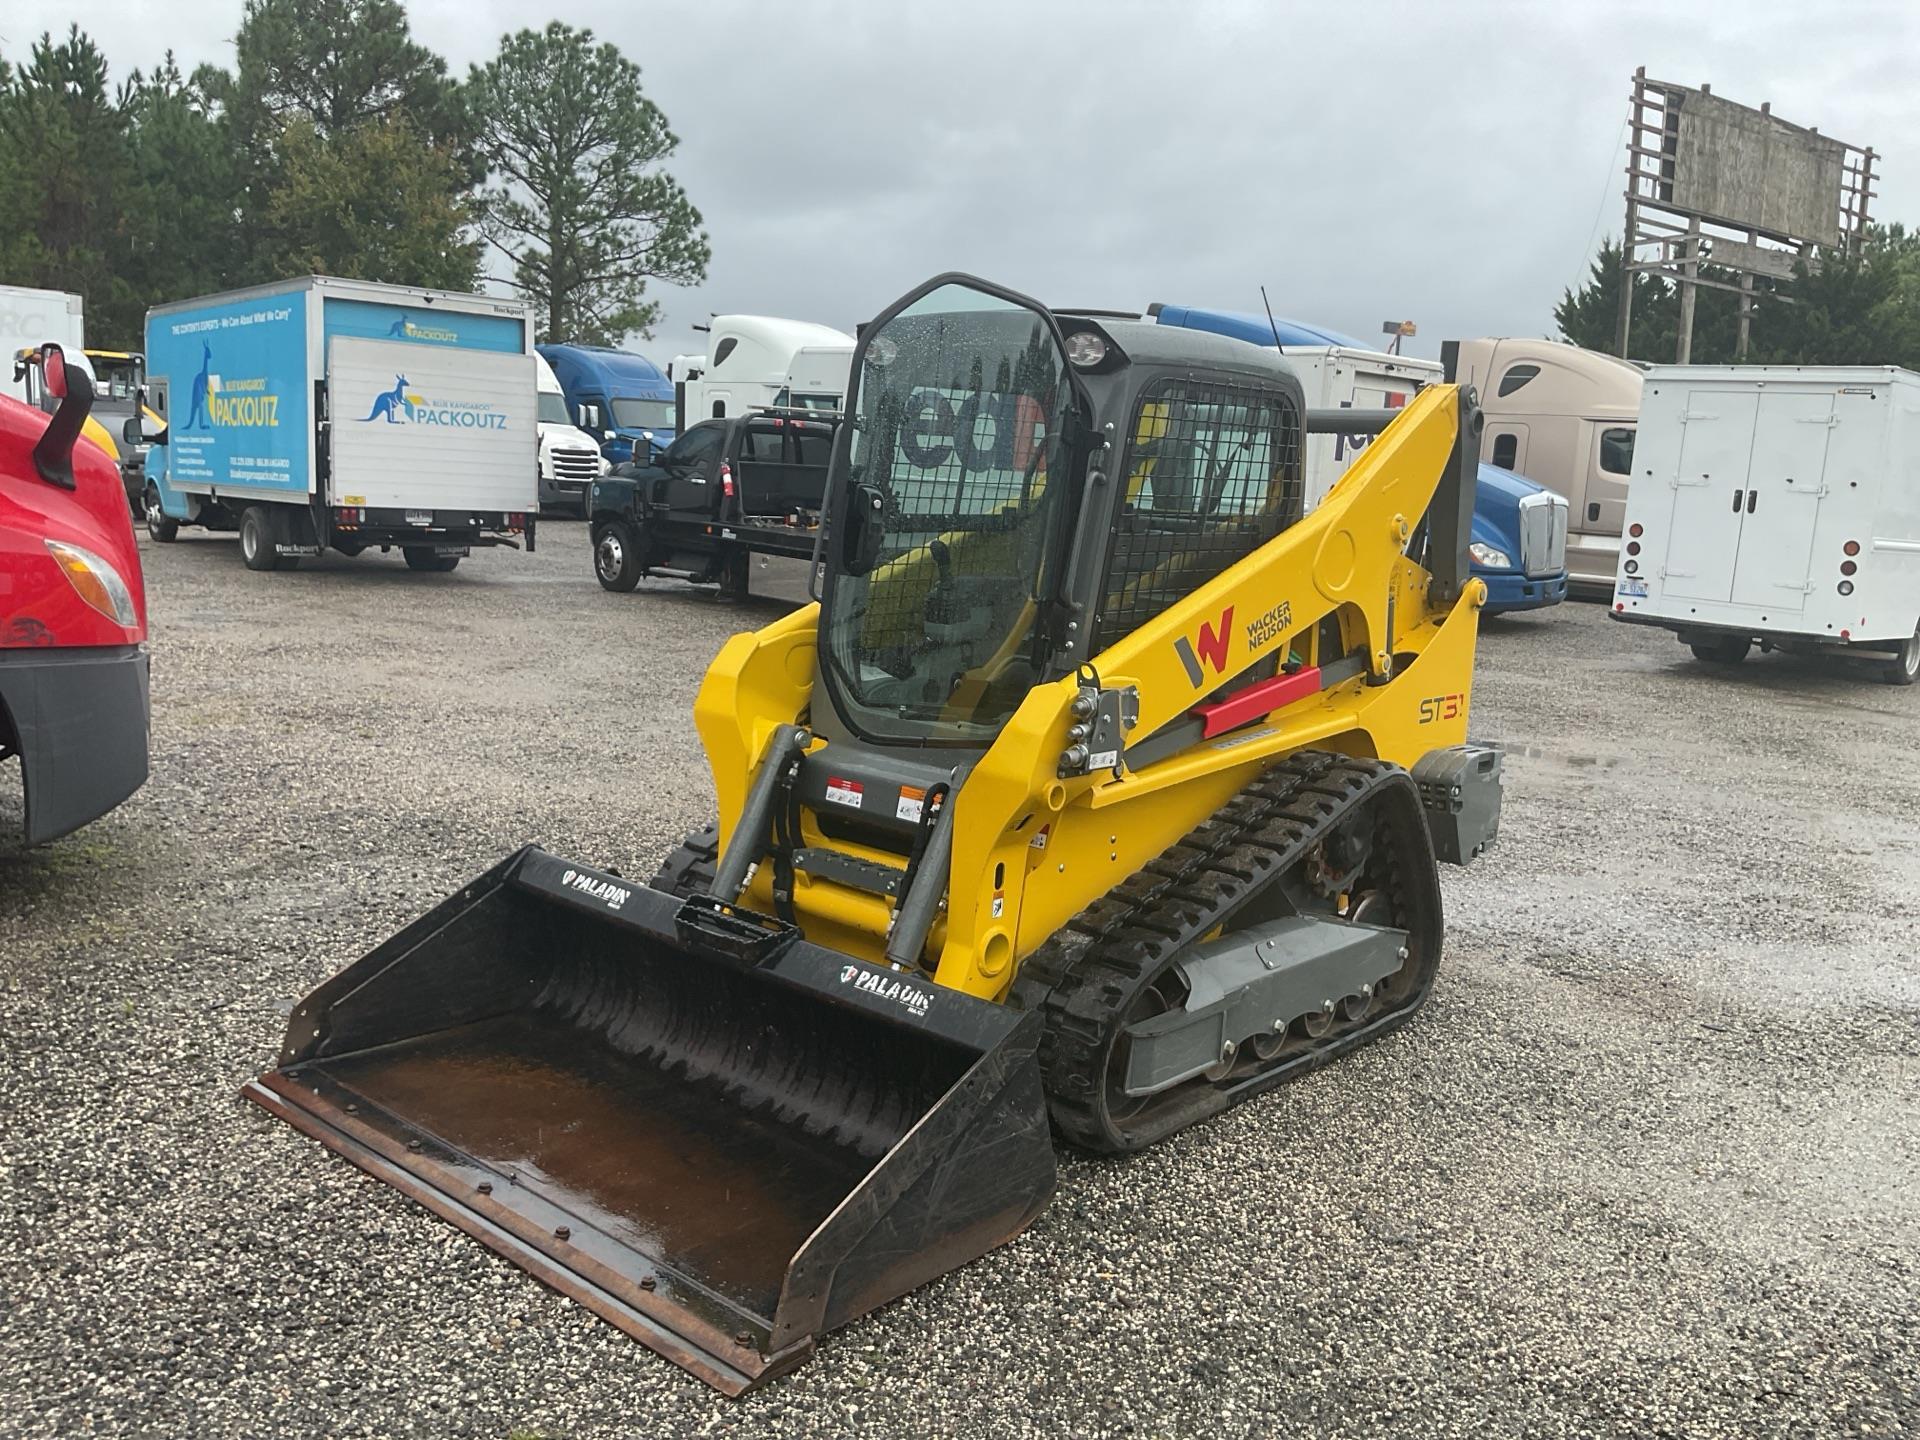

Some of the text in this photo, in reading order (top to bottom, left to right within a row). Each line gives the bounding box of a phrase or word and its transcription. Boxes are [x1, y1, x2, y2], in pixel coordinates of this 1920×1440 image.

[215, 395, 279, 427] PACKOUTZ
[416, 408, 507, 430] PACKOUTZ
[275, 543, 319, 554] Rockport
[1246, 600, 1291, 638] WACKER
[1248, 612, 1292, 652] NEUSON
[572, 873, 631, 905] PALADIN
[854, 970, 935, 1010] PALADIN
